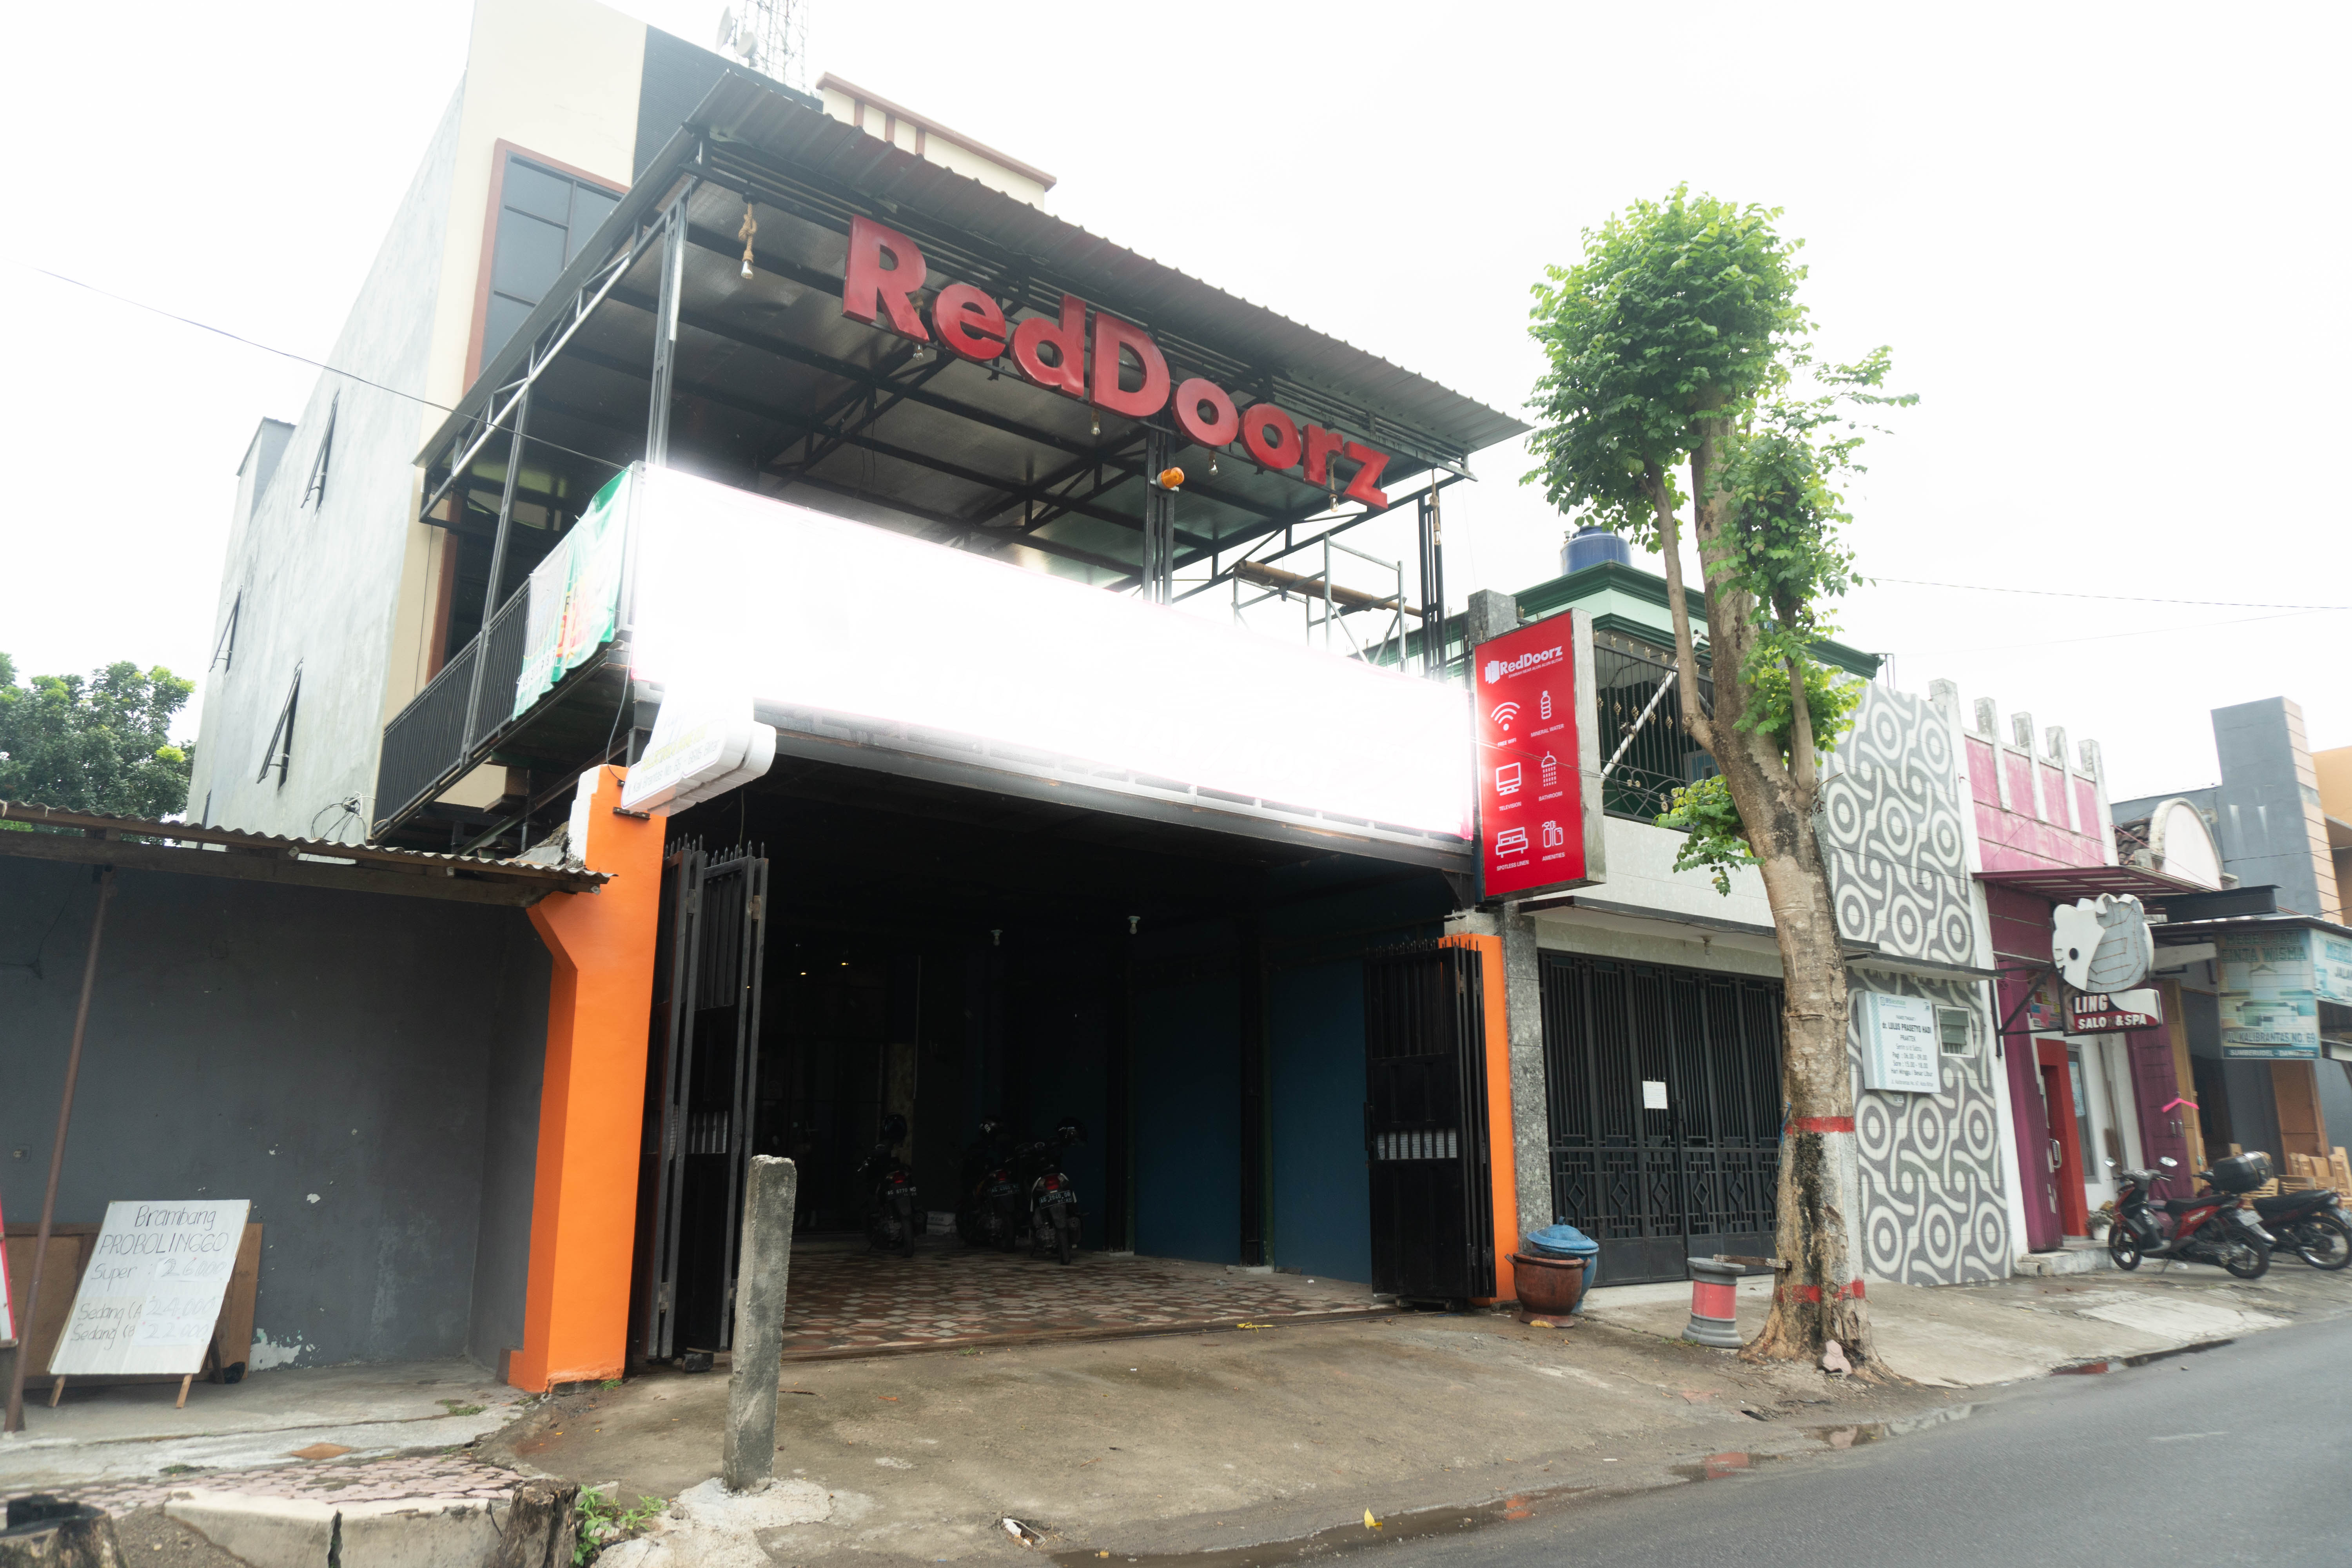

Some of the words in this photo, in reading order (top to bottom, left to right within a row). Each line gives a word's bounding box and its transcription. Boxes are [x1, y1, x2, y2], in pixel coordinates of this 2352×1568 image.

[842, 214, 1390, 509] RedDoorz
[1500, 646, 1563, 675] RedDoorz
[1530, 728, 1549, 737] MINERAL
[1499, 801, 1521, 811] TELEVISION
[1539, 791, 1563, 801] BATHROOM
[1497, 862, 1516, 871] SPOTLESS
[1542, 853, 1565, 862] AMENITIES
[2075, 995, 2108, 1013] LING
[135, 1205, 216, 1231] Brambang
[99, 1232, 229, 1255] PROBOLINGGO
[91, 1263, 138, 1292] Super
[77, 1303, 125, 1330] Sedang
[70, 1323, 116, 1350] Sedang
